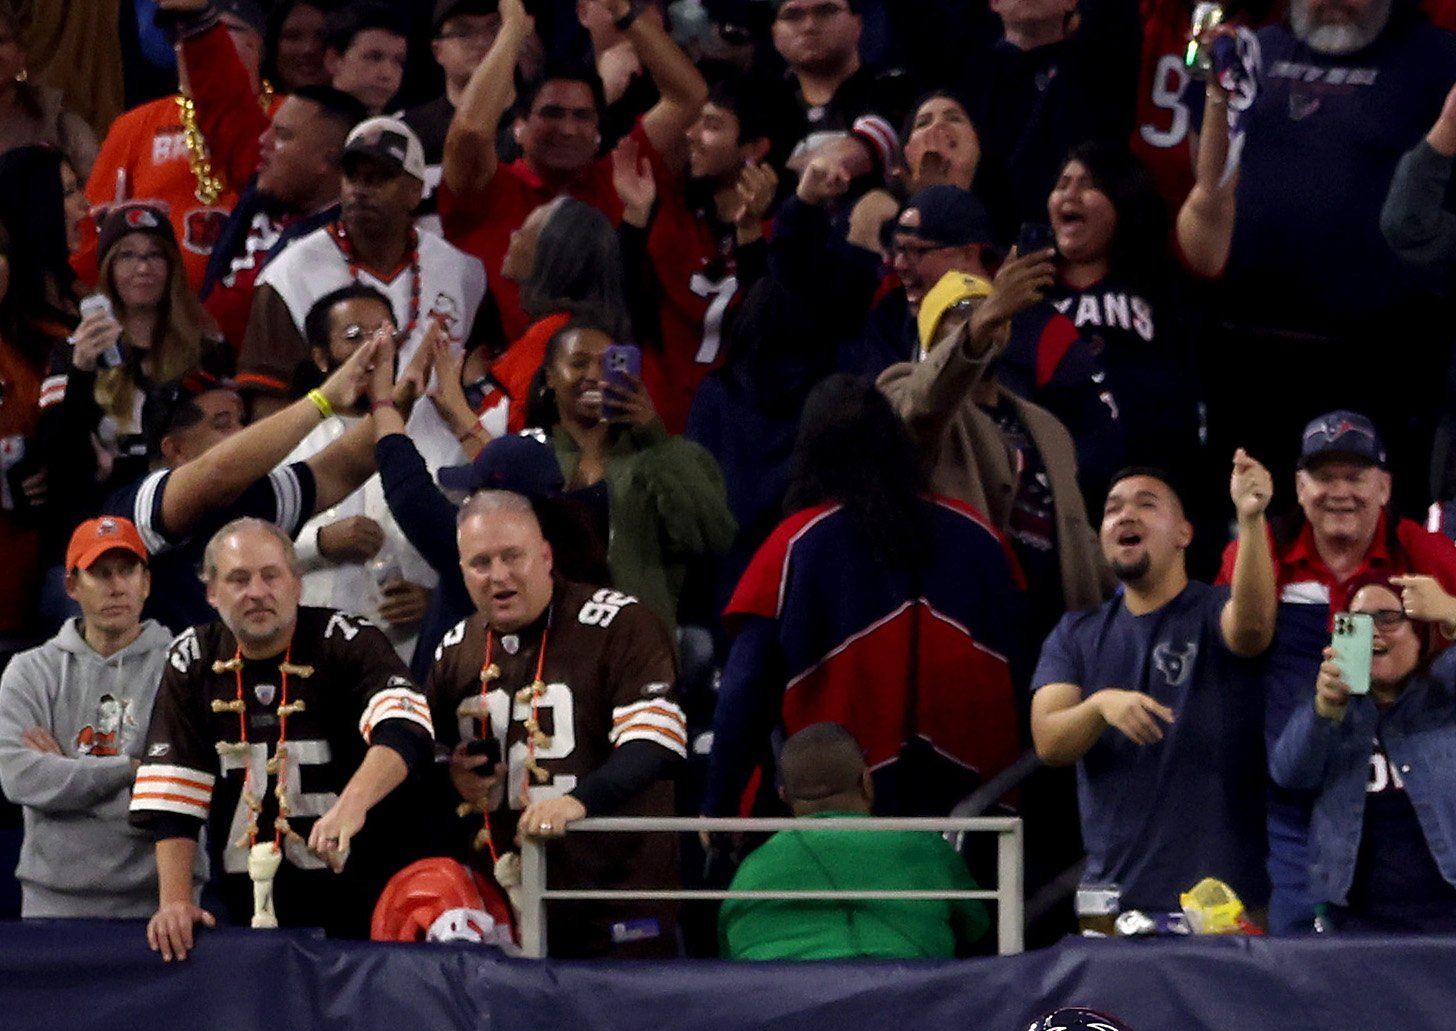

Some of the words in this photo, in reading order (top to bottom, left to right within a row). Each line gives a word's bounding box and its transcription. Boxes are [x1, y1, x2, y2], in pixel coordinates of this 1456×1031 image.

[690, 273, 738, 363] 7
[218, 740, 352, 874] 75
[457, 682, 578, 818] 92
